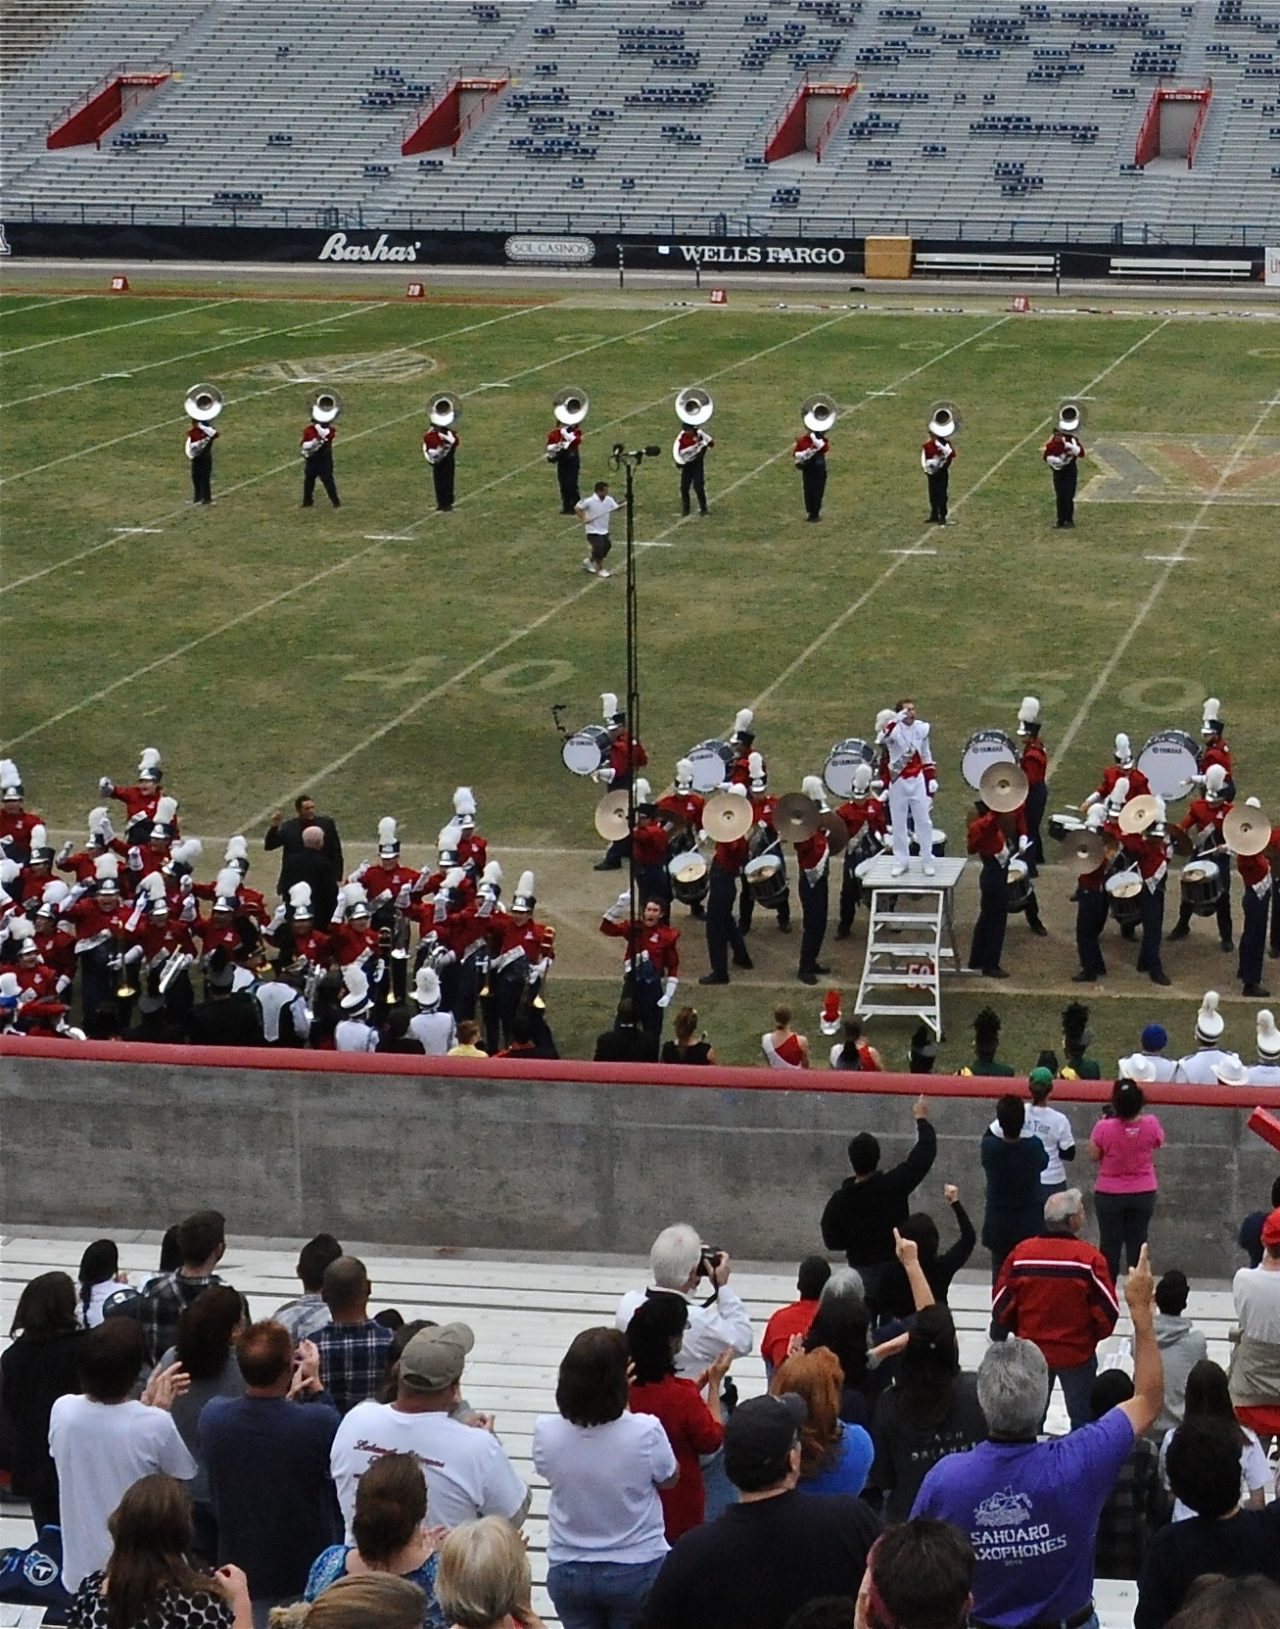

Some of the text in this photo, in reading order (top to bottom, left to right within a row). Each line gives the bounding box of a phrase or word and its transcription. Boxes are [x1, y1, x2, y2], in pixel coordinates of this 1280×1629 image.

[318, 232, 422, 262] Bashas'
[514, 243, 586, 255] SOL CASINOS
[680, 245, 845, 264] WELLS FARGO
[970, 1522, 1050, 1546] SAHUARO
